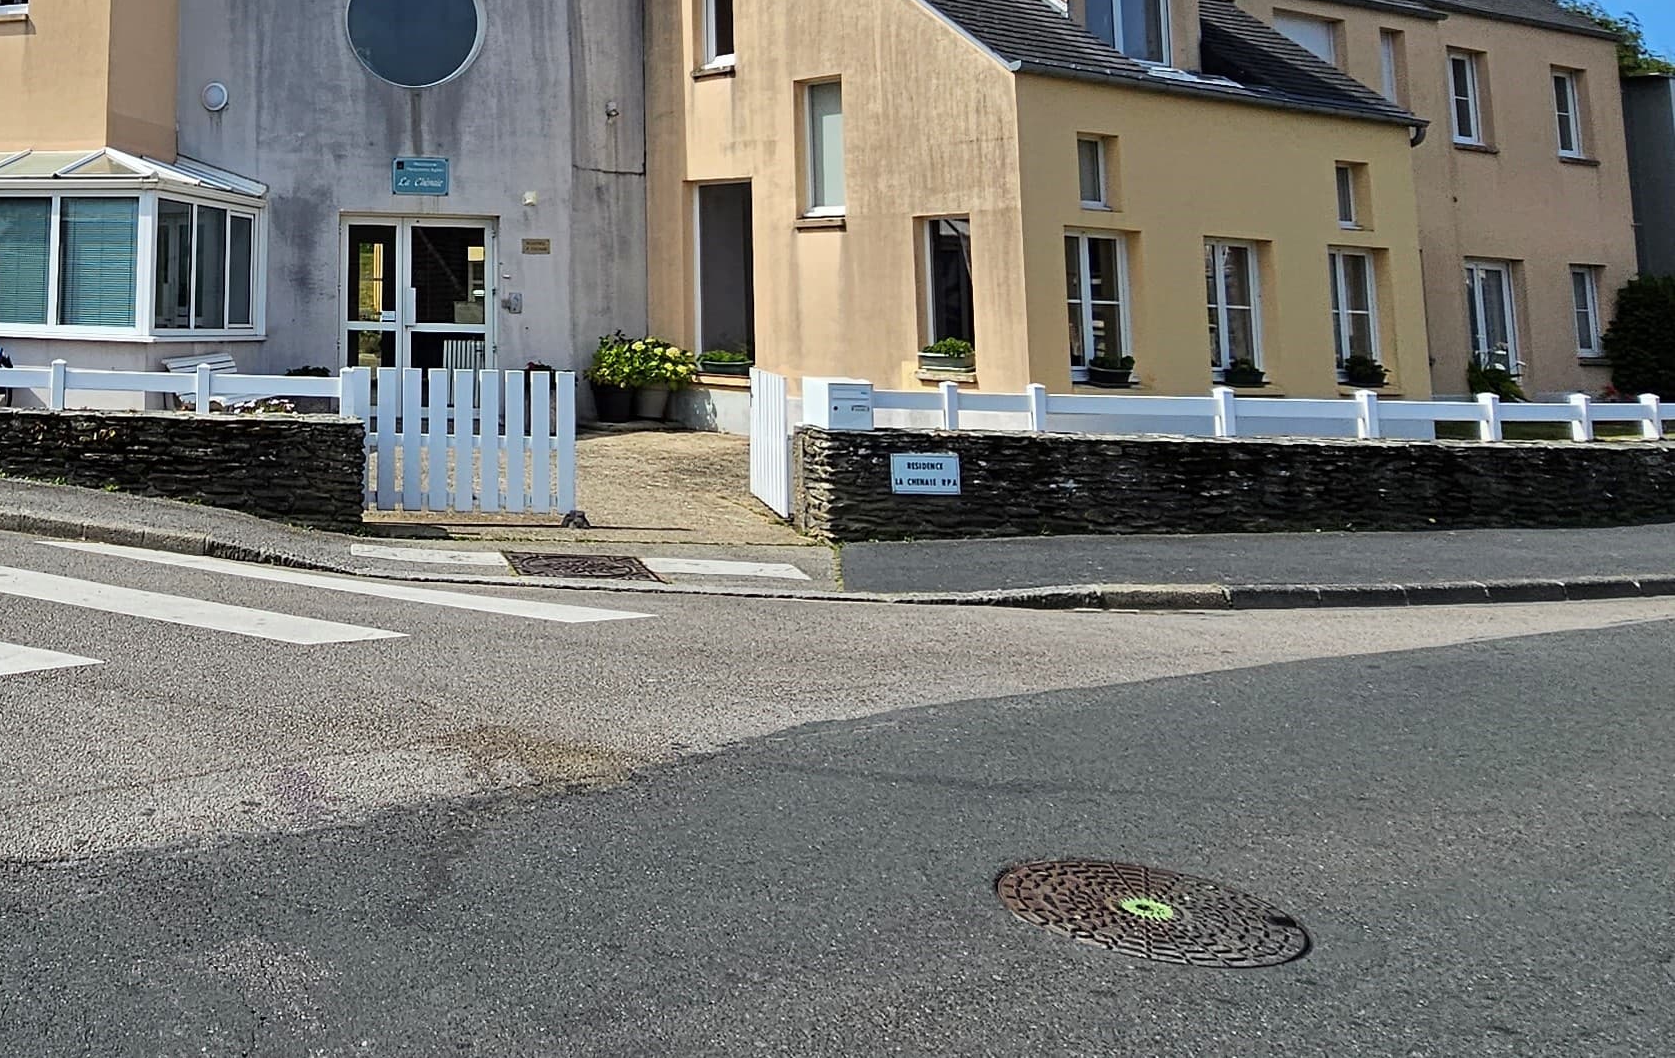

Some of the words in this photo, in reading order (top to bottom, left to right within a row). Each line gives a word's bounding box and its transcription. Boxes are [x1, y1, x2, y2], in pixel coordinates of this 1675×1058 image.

[907, 462, 943, 471] RESIDENCE
[895, 478, 903, 487] LA
[907, 478, 937, 487] CHENAIE
